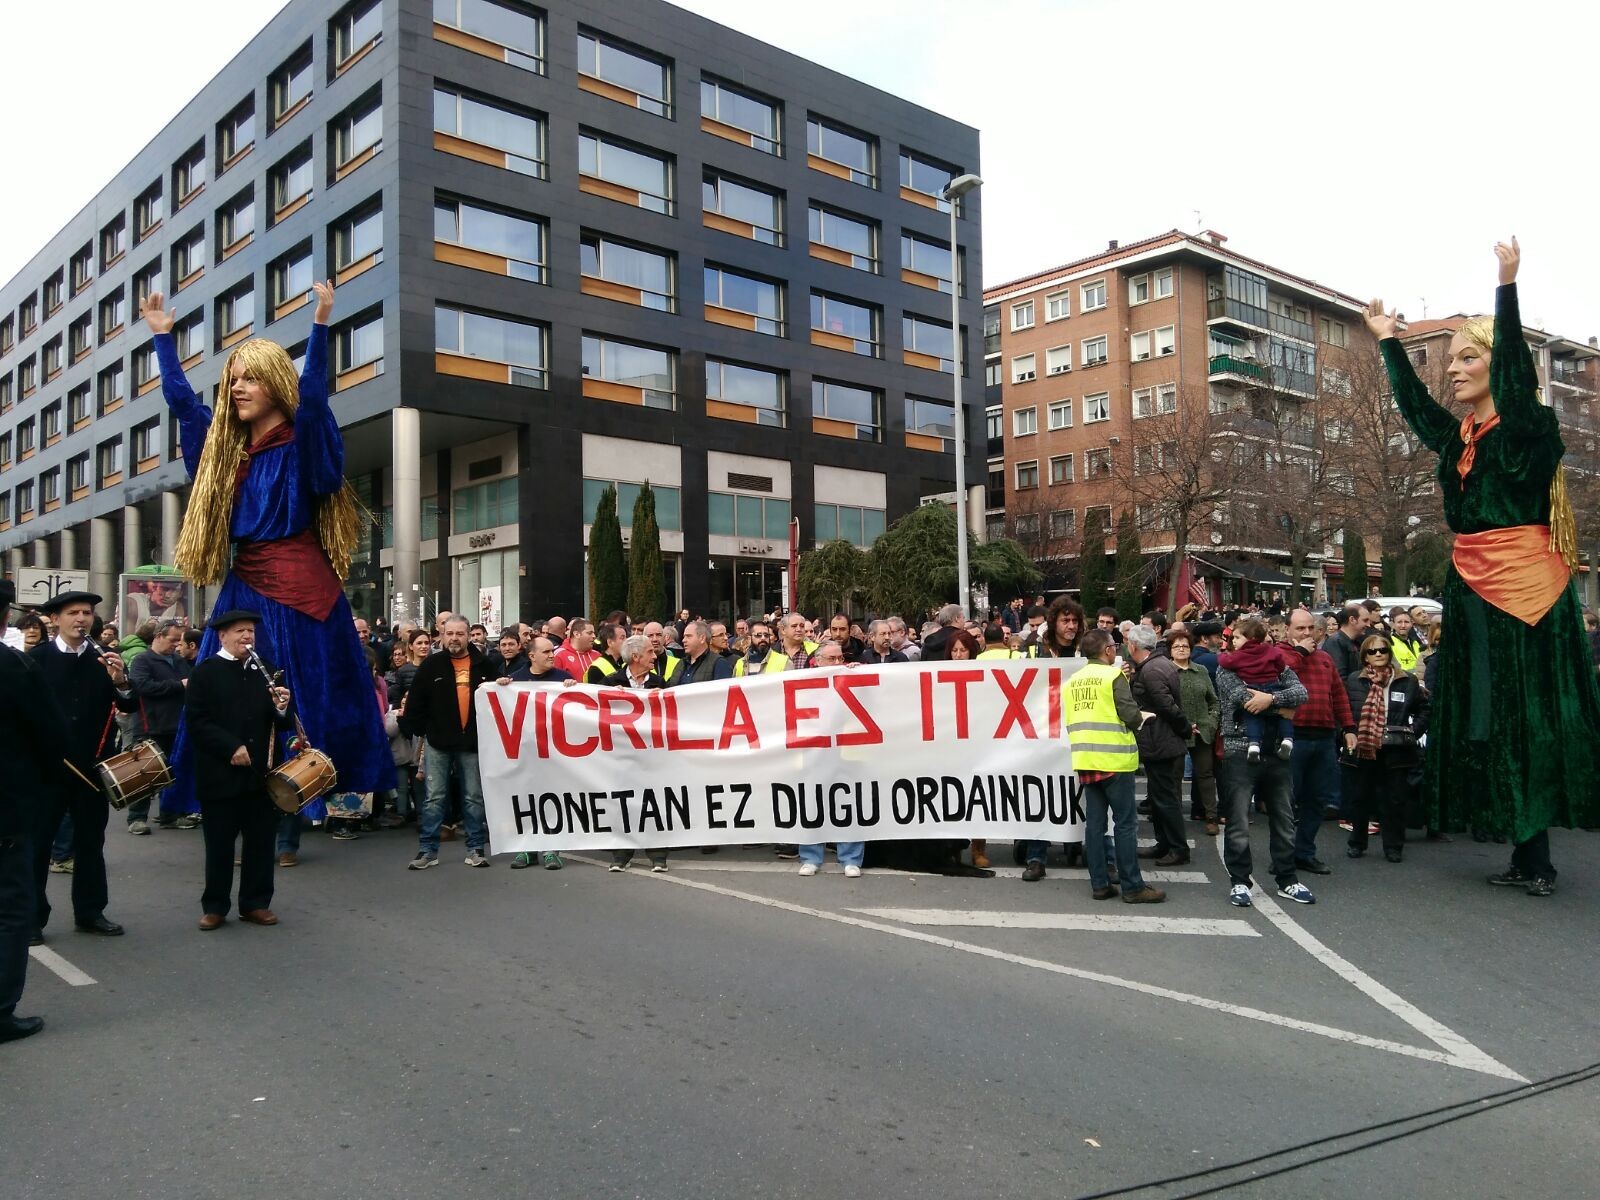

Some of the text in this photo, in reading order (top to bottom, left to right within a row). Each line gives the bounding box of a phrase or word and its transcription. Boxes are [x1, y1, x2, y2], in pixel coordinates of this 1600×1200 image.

[486, 685, 761, 760] VICRILA
[919, 667, 1062, 741] ITXI
[1071, 687, 1098, 702] VICRILA
[512, 785, 691, 835] HONETAN
[705, 783, 756, 829] EZ
[771, 780, 880, 829] DUGU
